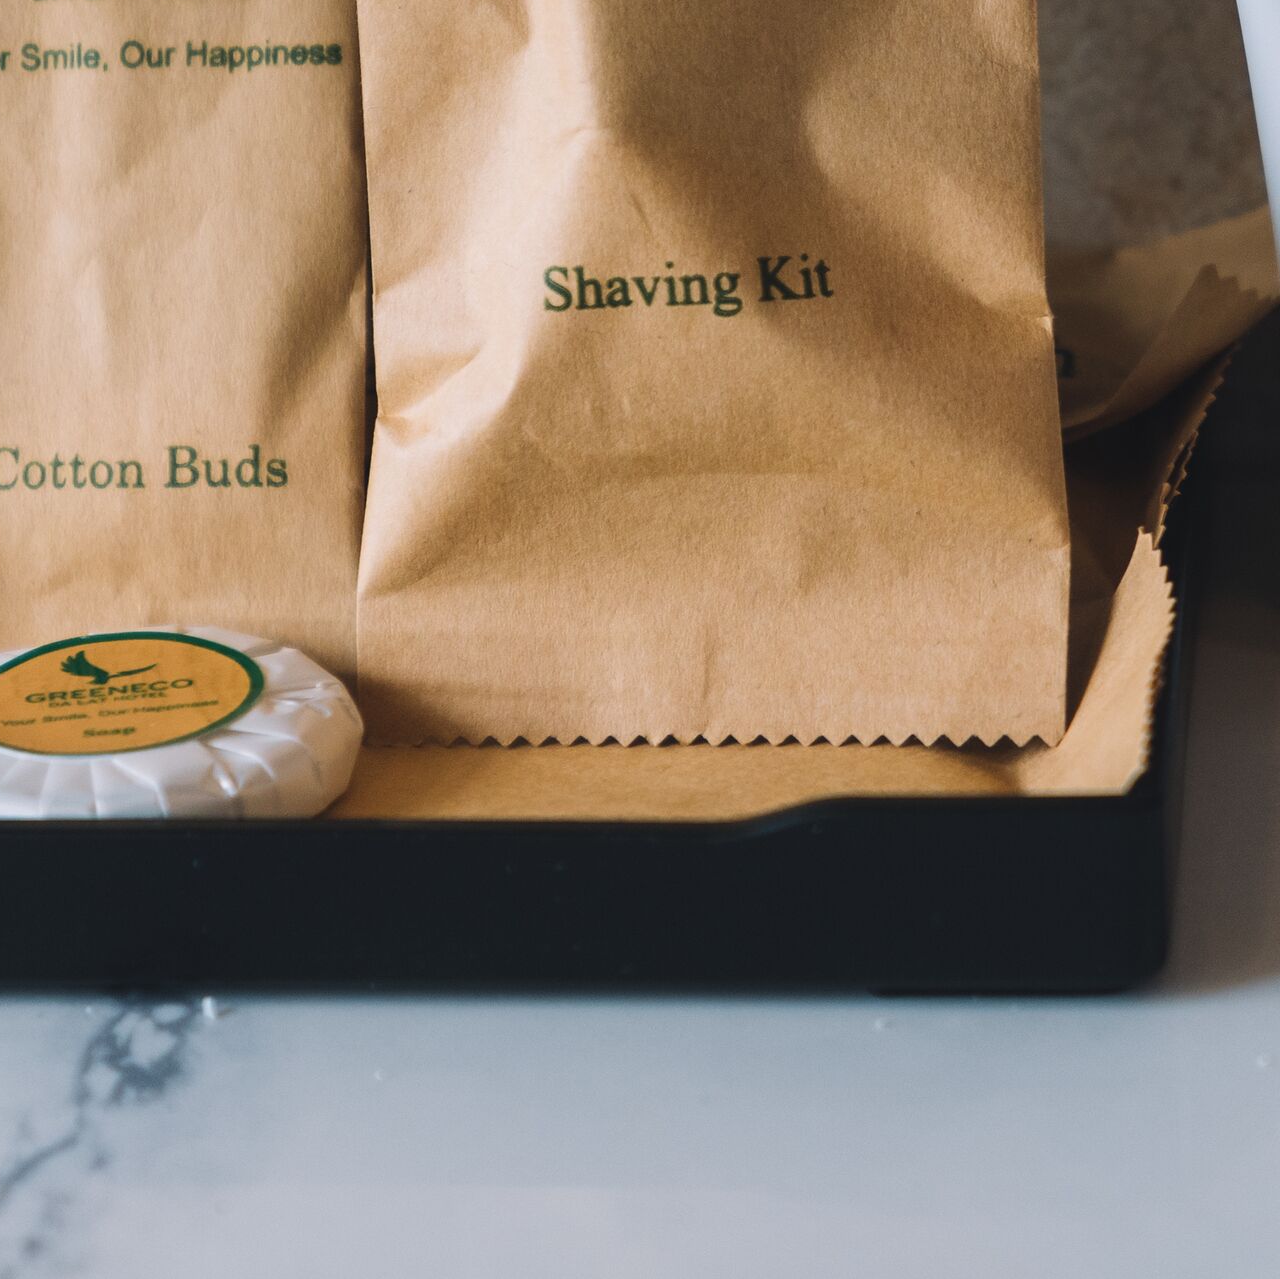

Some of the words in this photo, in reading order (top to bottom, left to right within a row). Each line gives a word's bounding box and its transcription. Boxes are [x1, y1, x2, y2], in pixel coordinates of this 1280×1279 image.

[21, 43, 109, 72] Smile,
[120, 41, 177, 69] Our
[186, 40, 343, 73] Happiness
[544, 261, 743, 317] Shaving
[757, 253, 834, 302] Kit
[164, 445, 289, 489] Buds
[25, 678, 194, 703] GREENECO
[48, 700, 71, 708] DA
[77, 697, 107, 706] LAT
[83, 726, 136, 737] Soap
